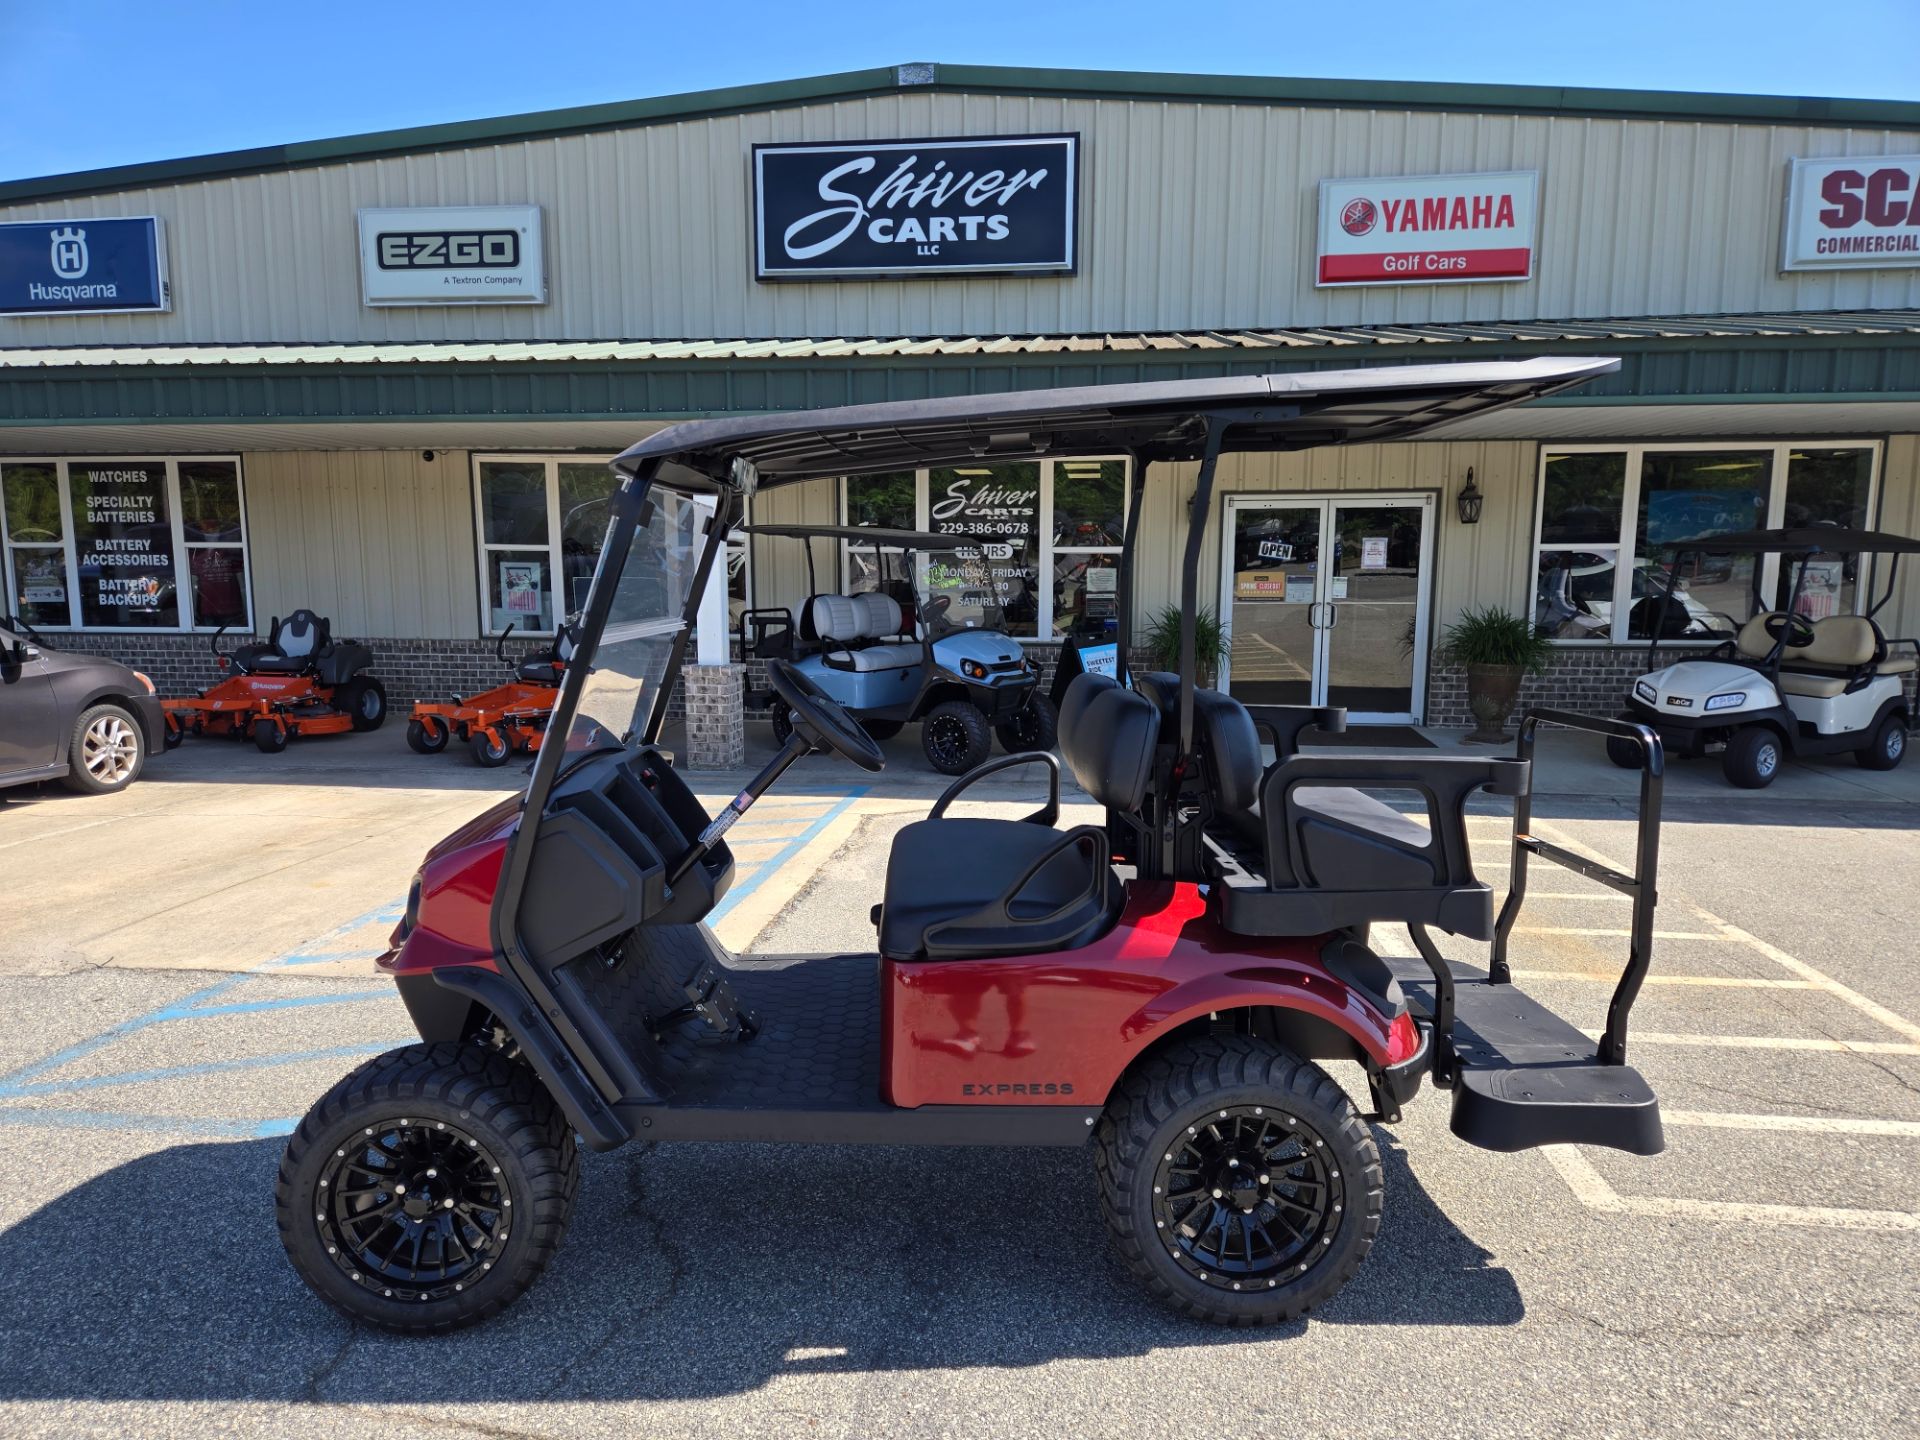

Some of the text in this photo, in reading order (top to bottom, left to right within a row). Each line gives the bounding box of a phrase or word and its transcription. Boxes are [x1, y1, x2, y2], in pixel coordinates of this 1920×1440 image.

[784, 155, 1048, 260] Shiver
[1381, 195, 1516, 233] YAMAHA
[868, 214, 1010, 244] CARTS
[381, 234, 515, 266] EZGO
[917, 244, 940, 256] LLC
[1816, 235, 1920, 254] COMMERCIAL
[1383, 254, 1467, 271] Golf Cars
[444, 275, 523, 286] A Textron Company
[29, 283, 117, 302] Husqvarna
[88, 470, 148, 483] WATCHES
[86, 495, 154, 508] SPECIALTY
[932, 479, 1037, 520] Shiver
[87, 511, 155, 523] BATTERIES
[964, 507, 1034, 516] CARTS
[940, 522, 1029, 534] 229-386-0678
[95, 539, 151, 551] BATTERY
[961, 545, 1007, 557] HOURS
[1261, 542, 1291, 559] OPEN
[83, 553, 169, 566] ACCESSORIES
[992, 568, 1028, 578] FRIDAY
[99, 579, 155, 591] BATTERY
[98, 593, 159, 606] BACKUPS
[962, 1083, 1074, 1096] EXPRESS
